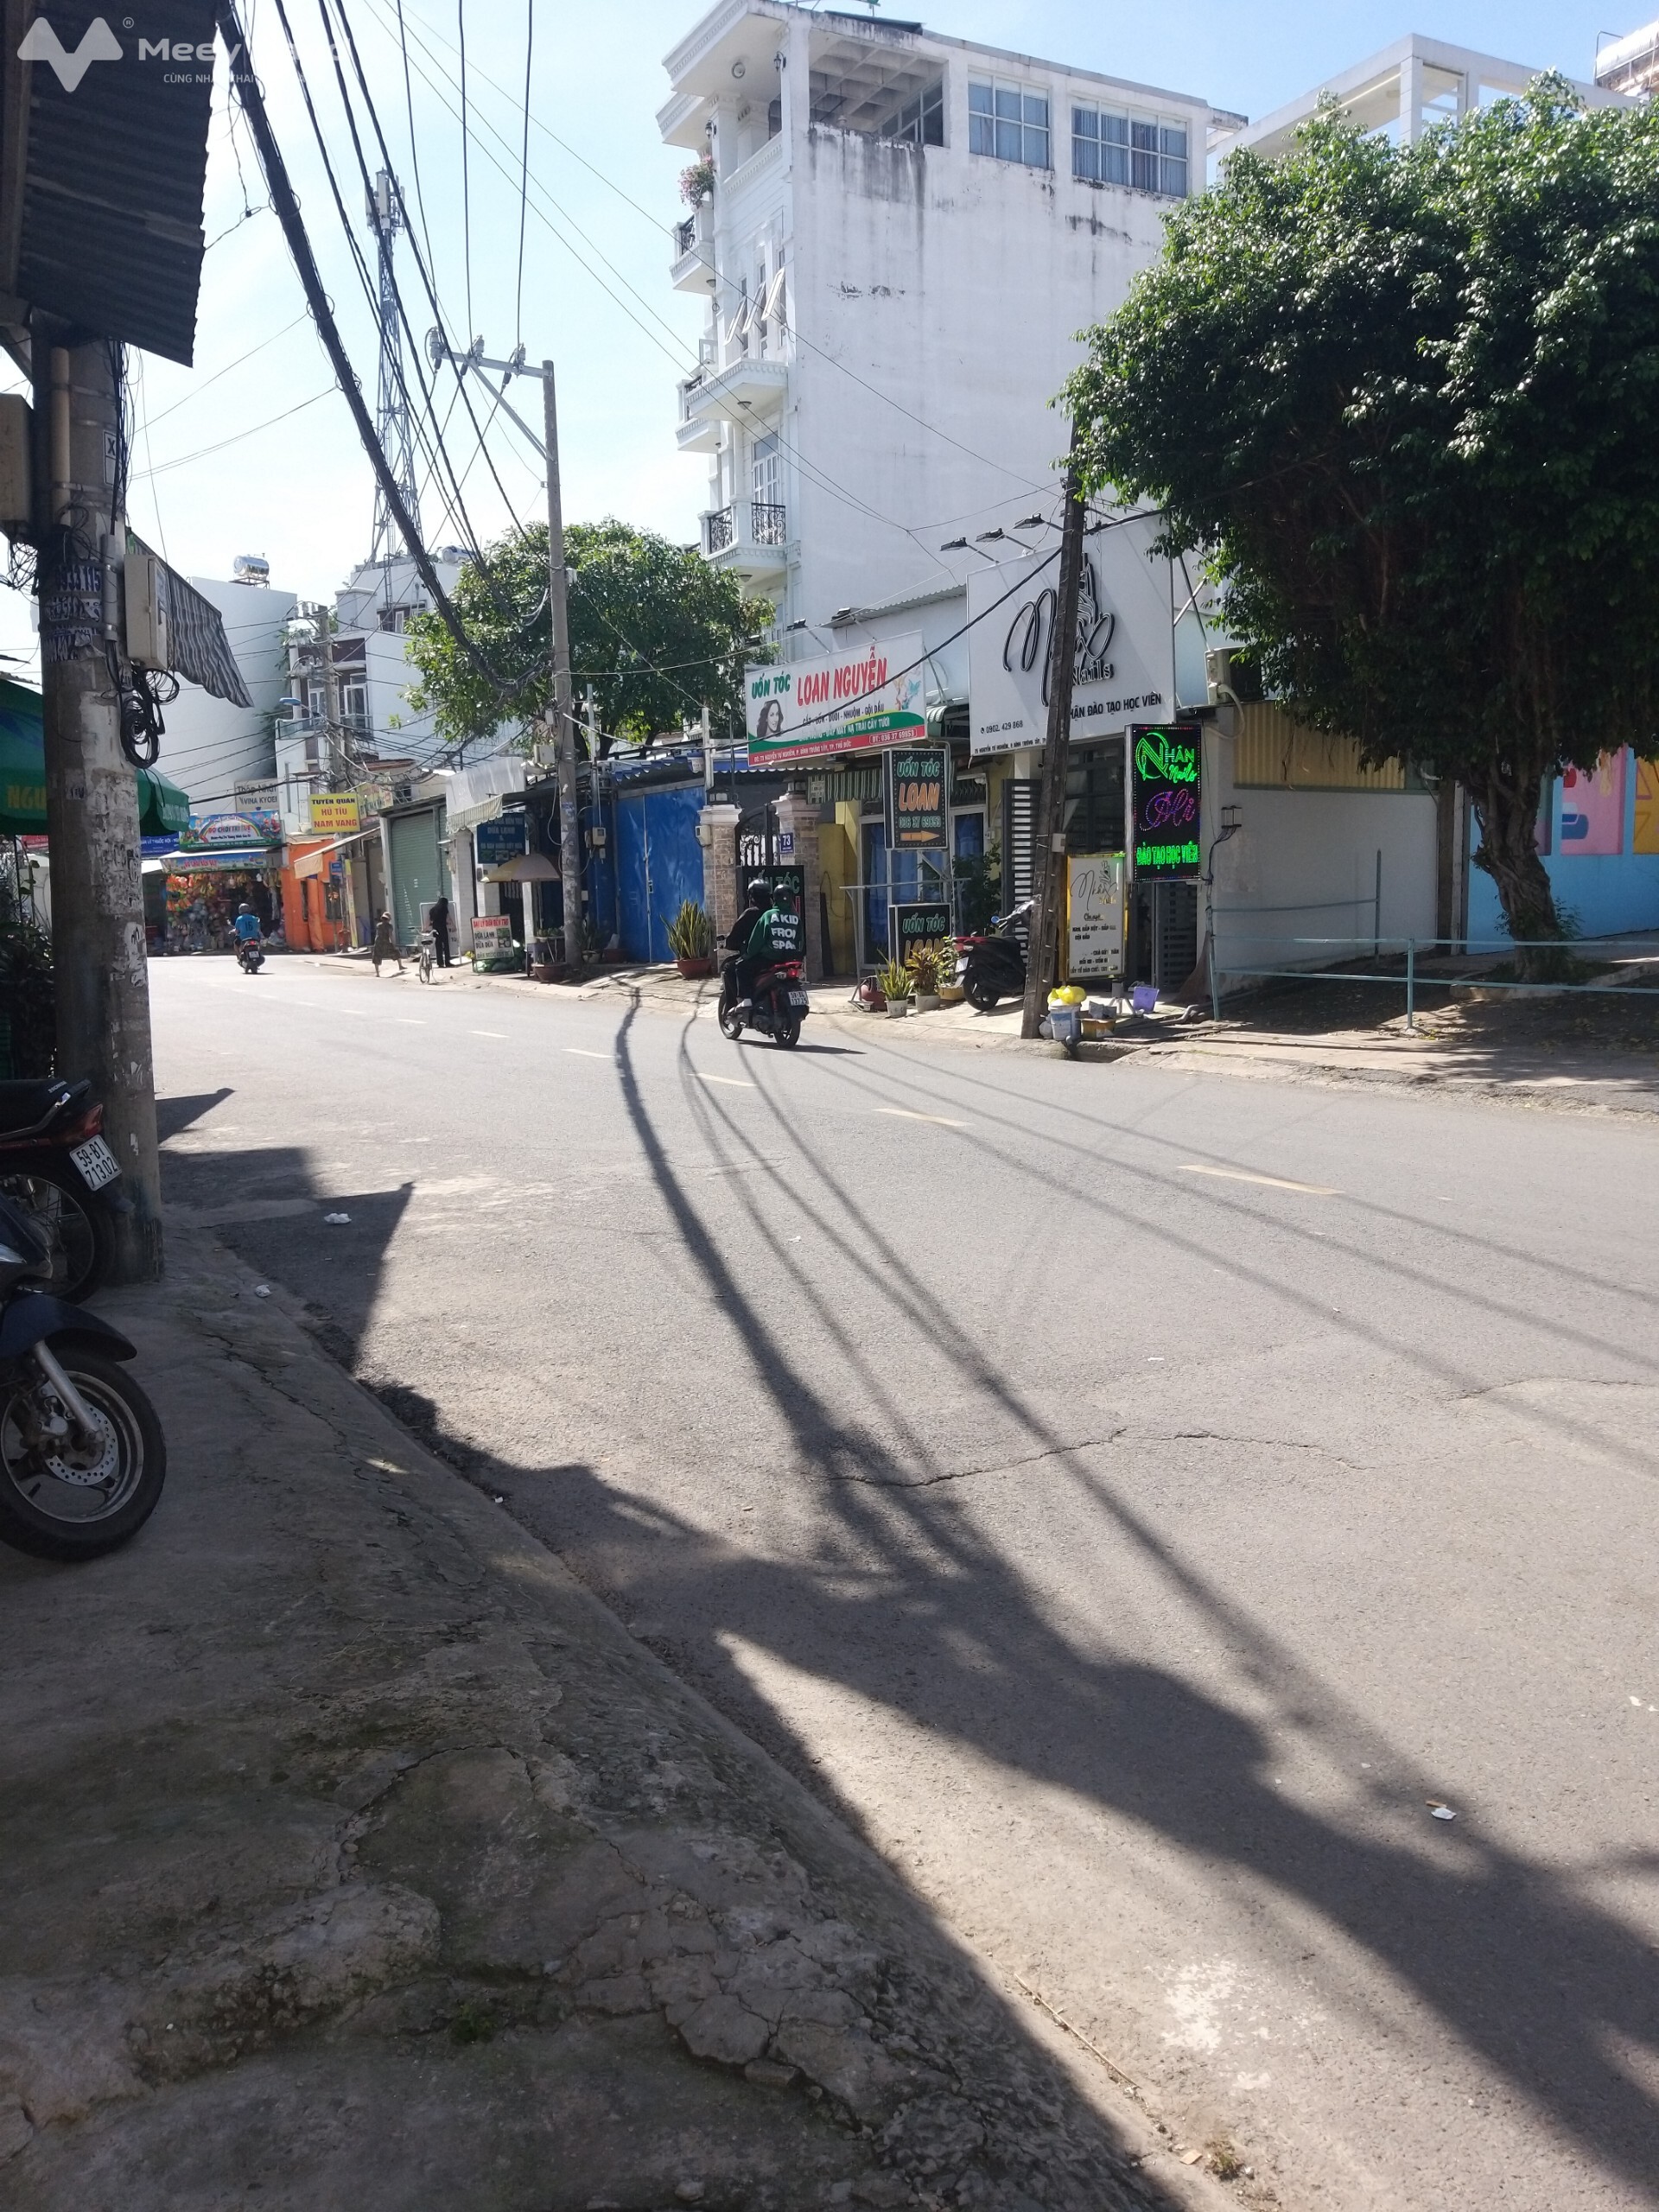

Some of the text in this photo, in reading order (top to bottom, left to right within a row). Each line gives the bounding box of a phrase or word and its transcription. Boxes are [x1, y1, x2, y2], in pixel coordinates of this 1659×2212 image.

[752, 645, 887, 706] UỐN TÓC LOAN NGUYỄN
[1087, 701, 1103, 717] ĐÀO
[1106, 701, 1121, 715] TẠO
[1123, 696, 1139, 712] HỌC
[1142, 690, 1161, 706] VIÊN
[1001, 721, 1012, 732] 429
[1012, 720, 1024, 730] 868
[897, 757, 940, 778] UỐN TÓC
[898, 782, 941, 812] LOAN
[335, 818, 357, 827] VANG
[782, 835, 791, 846] 73
[771, 913, 799, 925] A KID
[902, 912, 945, 934] UỐN TÓC
[76, 1141, 105, 1167] 59-B1
[85, 1156, 118, 1189] 713.02
